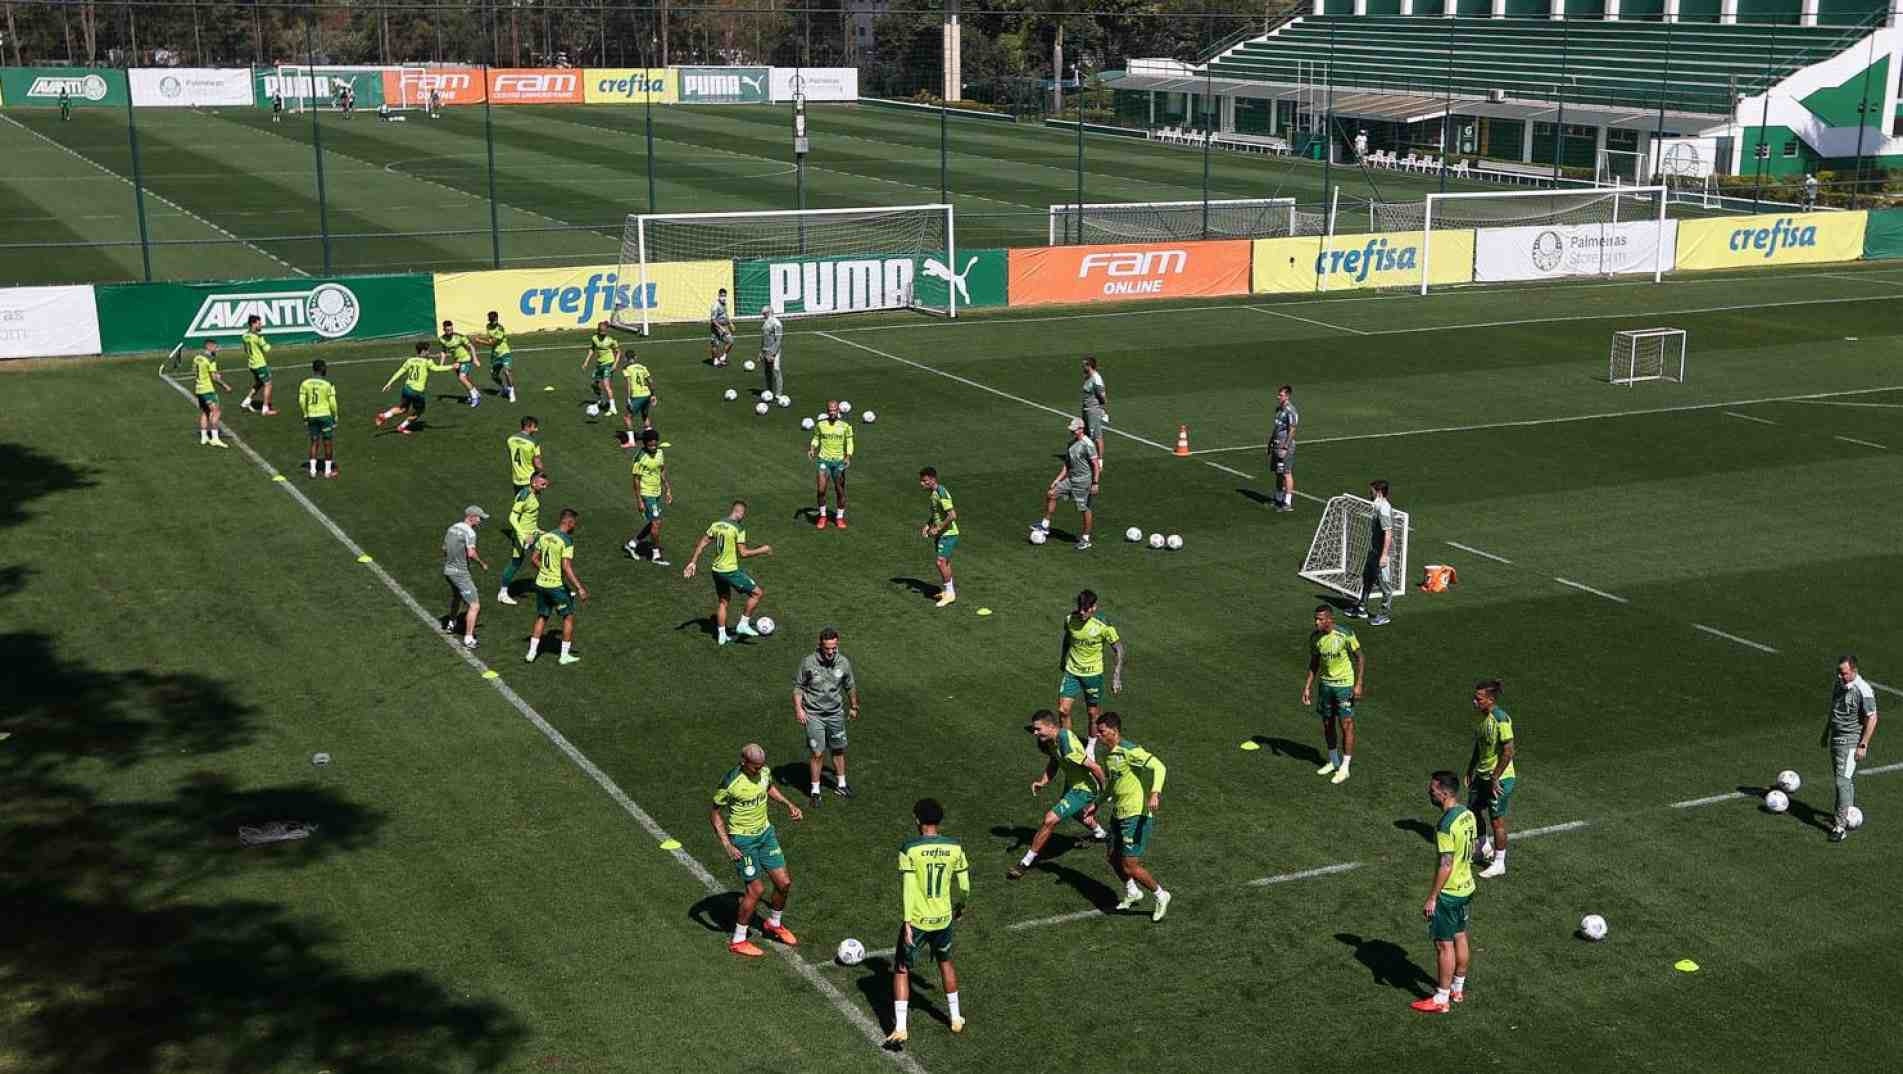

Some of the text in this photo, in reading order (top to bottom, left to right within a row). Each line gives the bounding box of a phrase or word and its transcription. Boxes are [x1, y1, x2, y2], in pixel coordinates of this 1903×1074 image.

[684, 75, 743, 96] PUMA
[1729, 218, 1816, 258] crefisa
[1314, 238, 1418, 283] crefisa
[519, 272, 659, 326] crefisa
[770, 257, 914, 315] PUMA
[1103, 280, 1164, 296] ONLINE
[201, 298, 305, 330] AVANTI
[926, 862, 947, 898] 17
